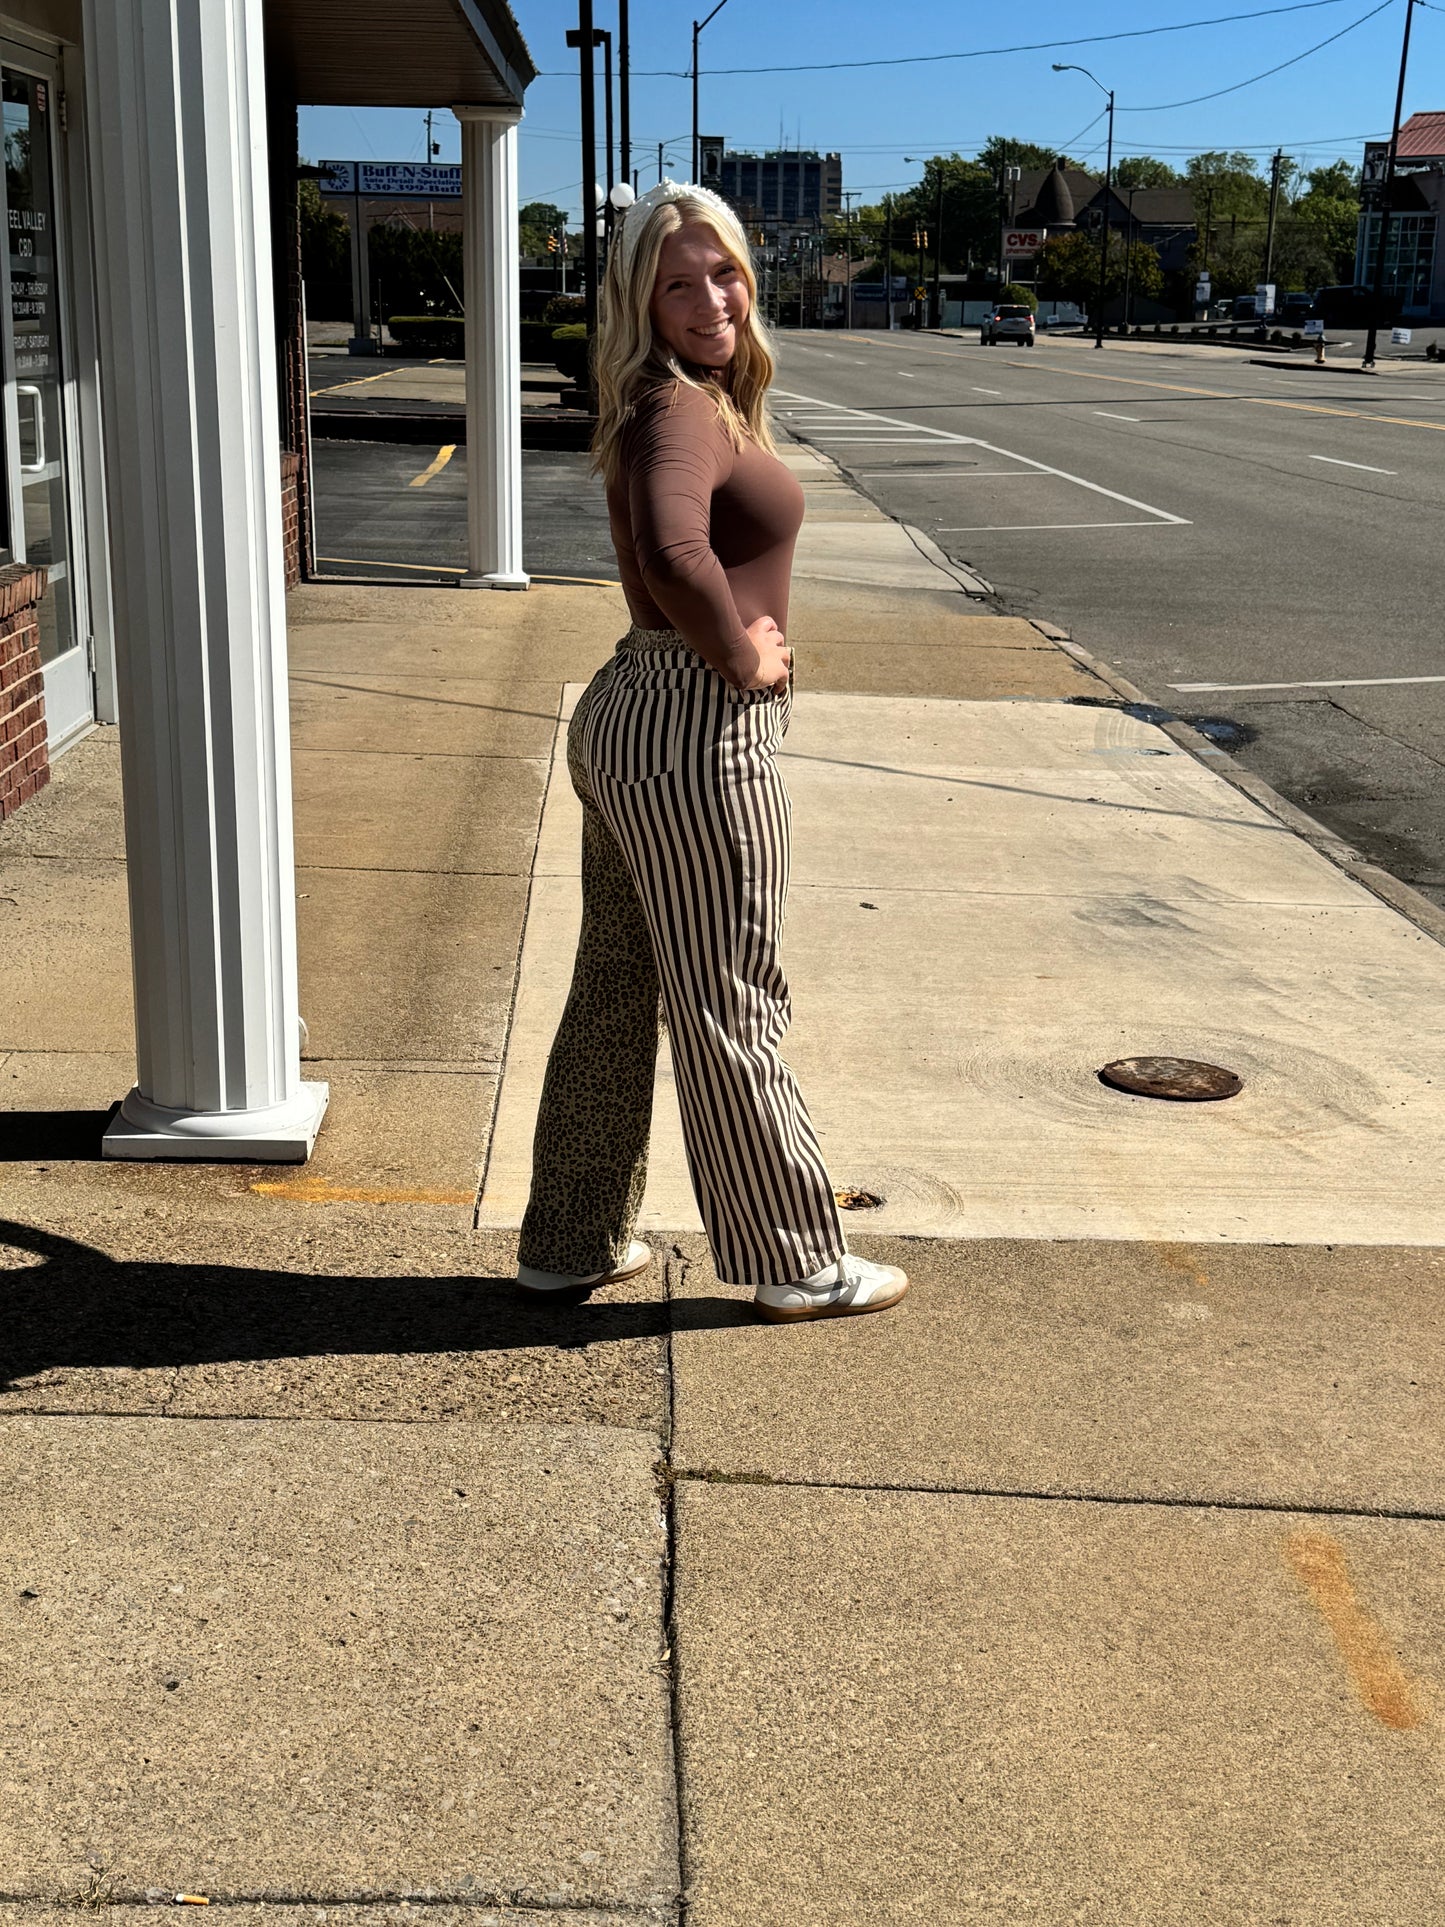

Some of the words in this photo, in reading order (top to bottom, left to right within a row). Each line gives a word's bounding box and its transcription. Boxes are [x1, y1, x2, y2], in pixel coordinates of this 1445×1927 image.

[362, 165, 462, 179] Buff-N-Stuff
[22, 210, 46, 231] VALLEY
[19, 238, 33, 257] CBD
[1007, 233, 1038, 247] CVS
